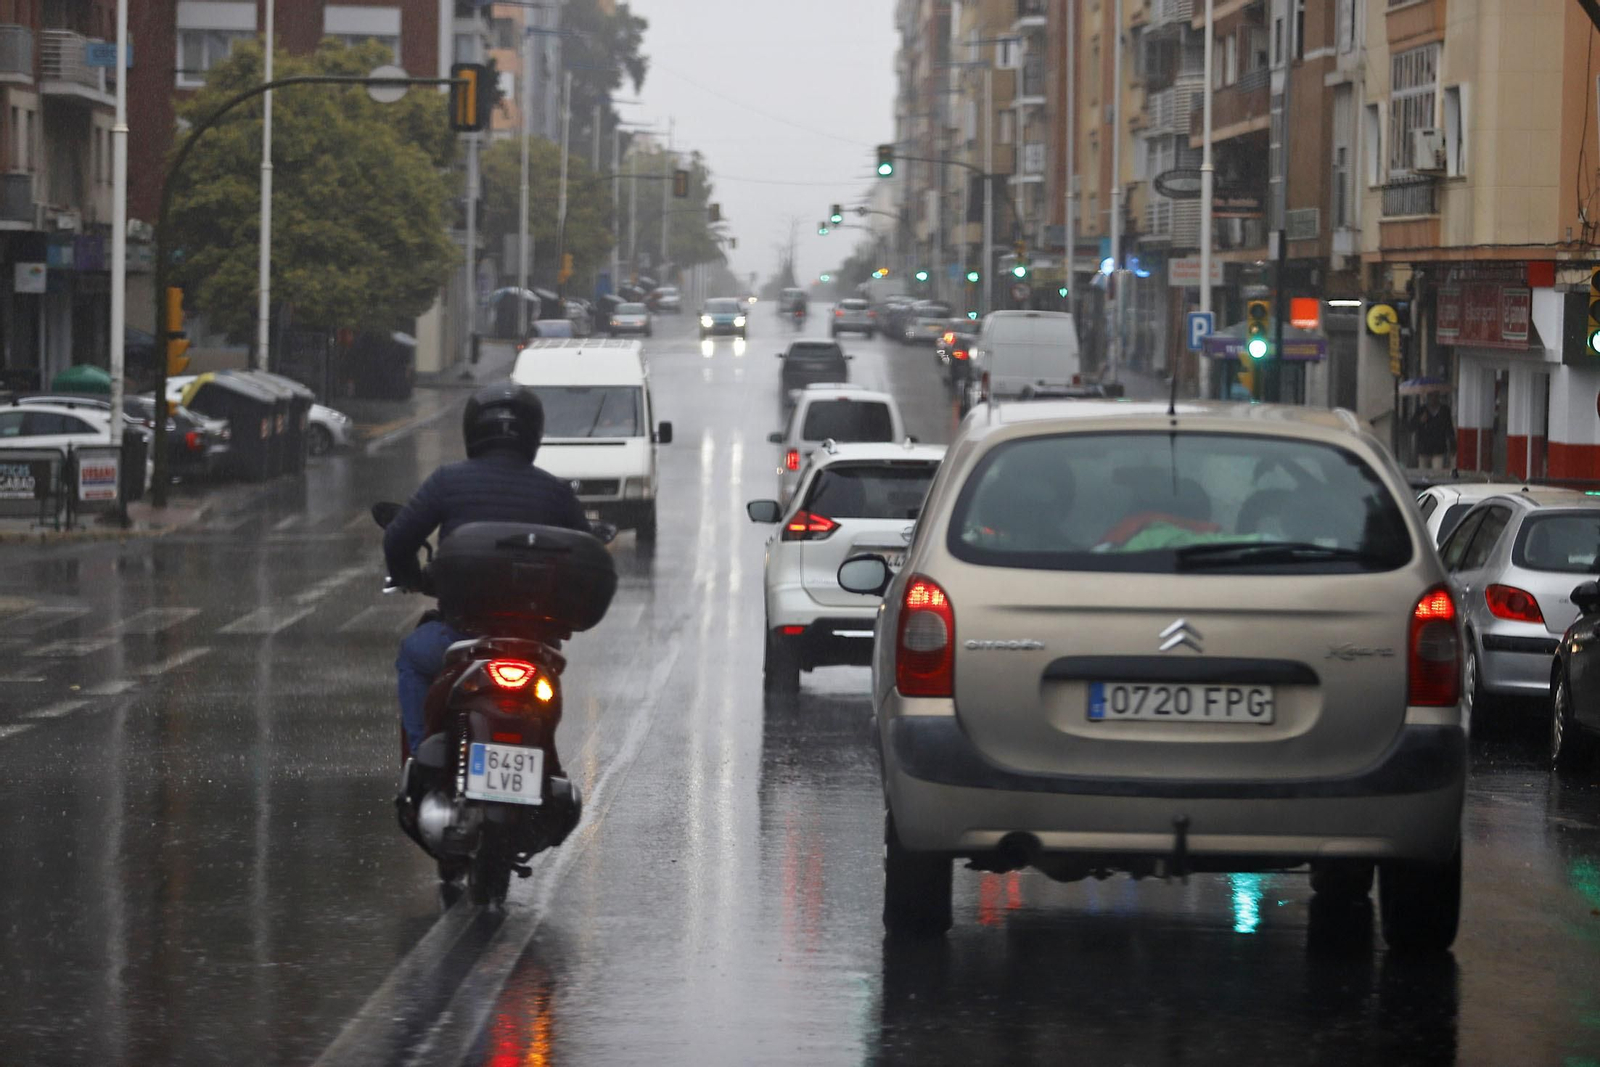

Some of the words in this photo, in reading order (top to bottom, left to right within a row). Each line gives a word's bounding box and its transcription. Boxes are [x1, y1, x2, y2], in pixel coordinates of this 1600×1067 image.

[1193, 317, 1208, 346] P
[1111, 685, 1193, 716] 0720
[1204, 687, 1266, 718] FPG
[488, 751, 535, 774] 6491
[486, 771, 523, 793] LVB
